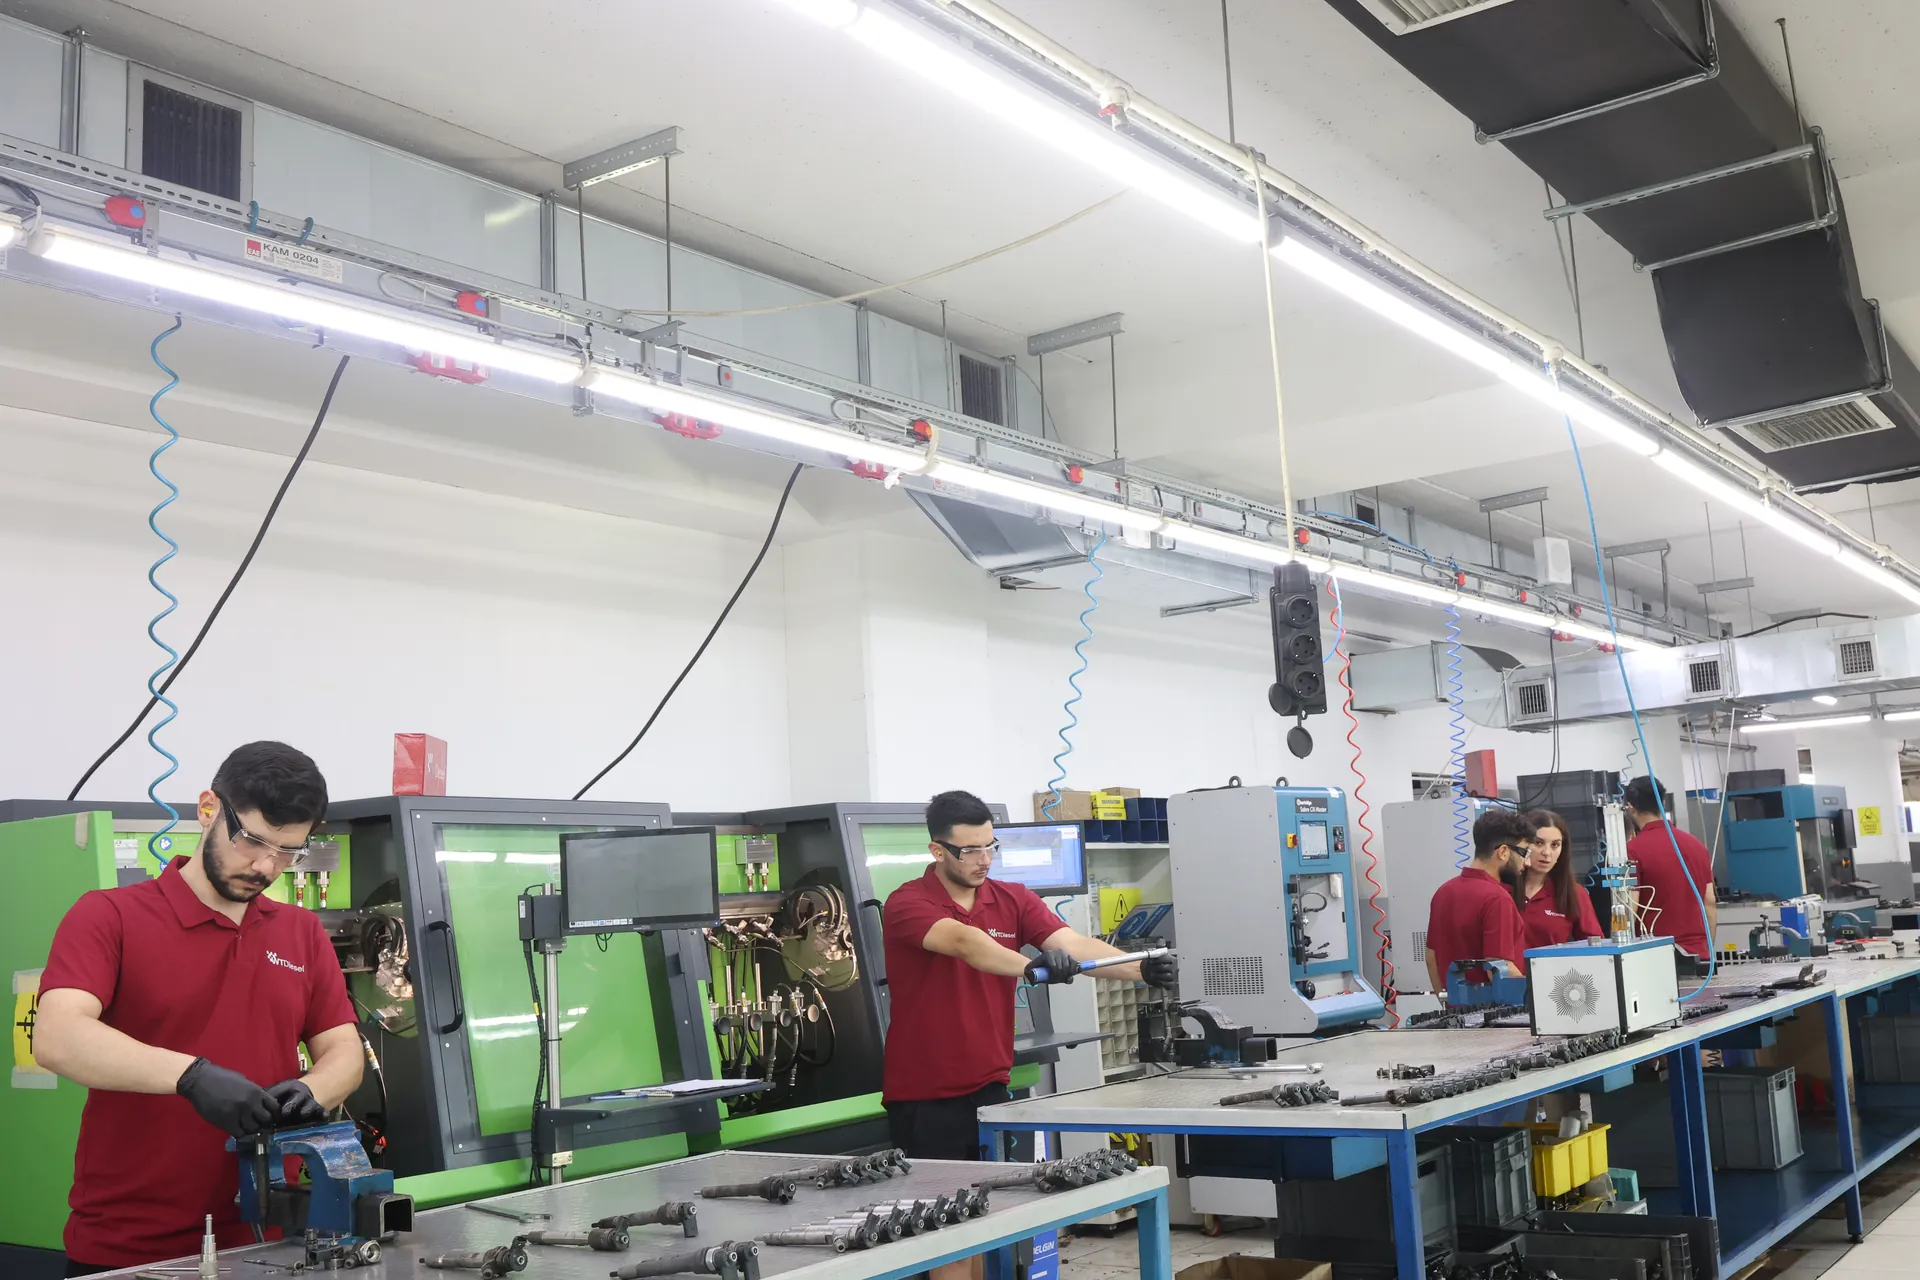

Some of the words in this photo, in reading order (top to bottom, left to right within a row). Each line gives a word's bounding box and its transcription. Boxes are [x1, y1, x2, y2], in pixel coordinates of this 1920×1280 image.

[247, 248, 261, 256] EAE
[263, 243, 289, 256] KAM
[292, 251, 319, 264] 0204
